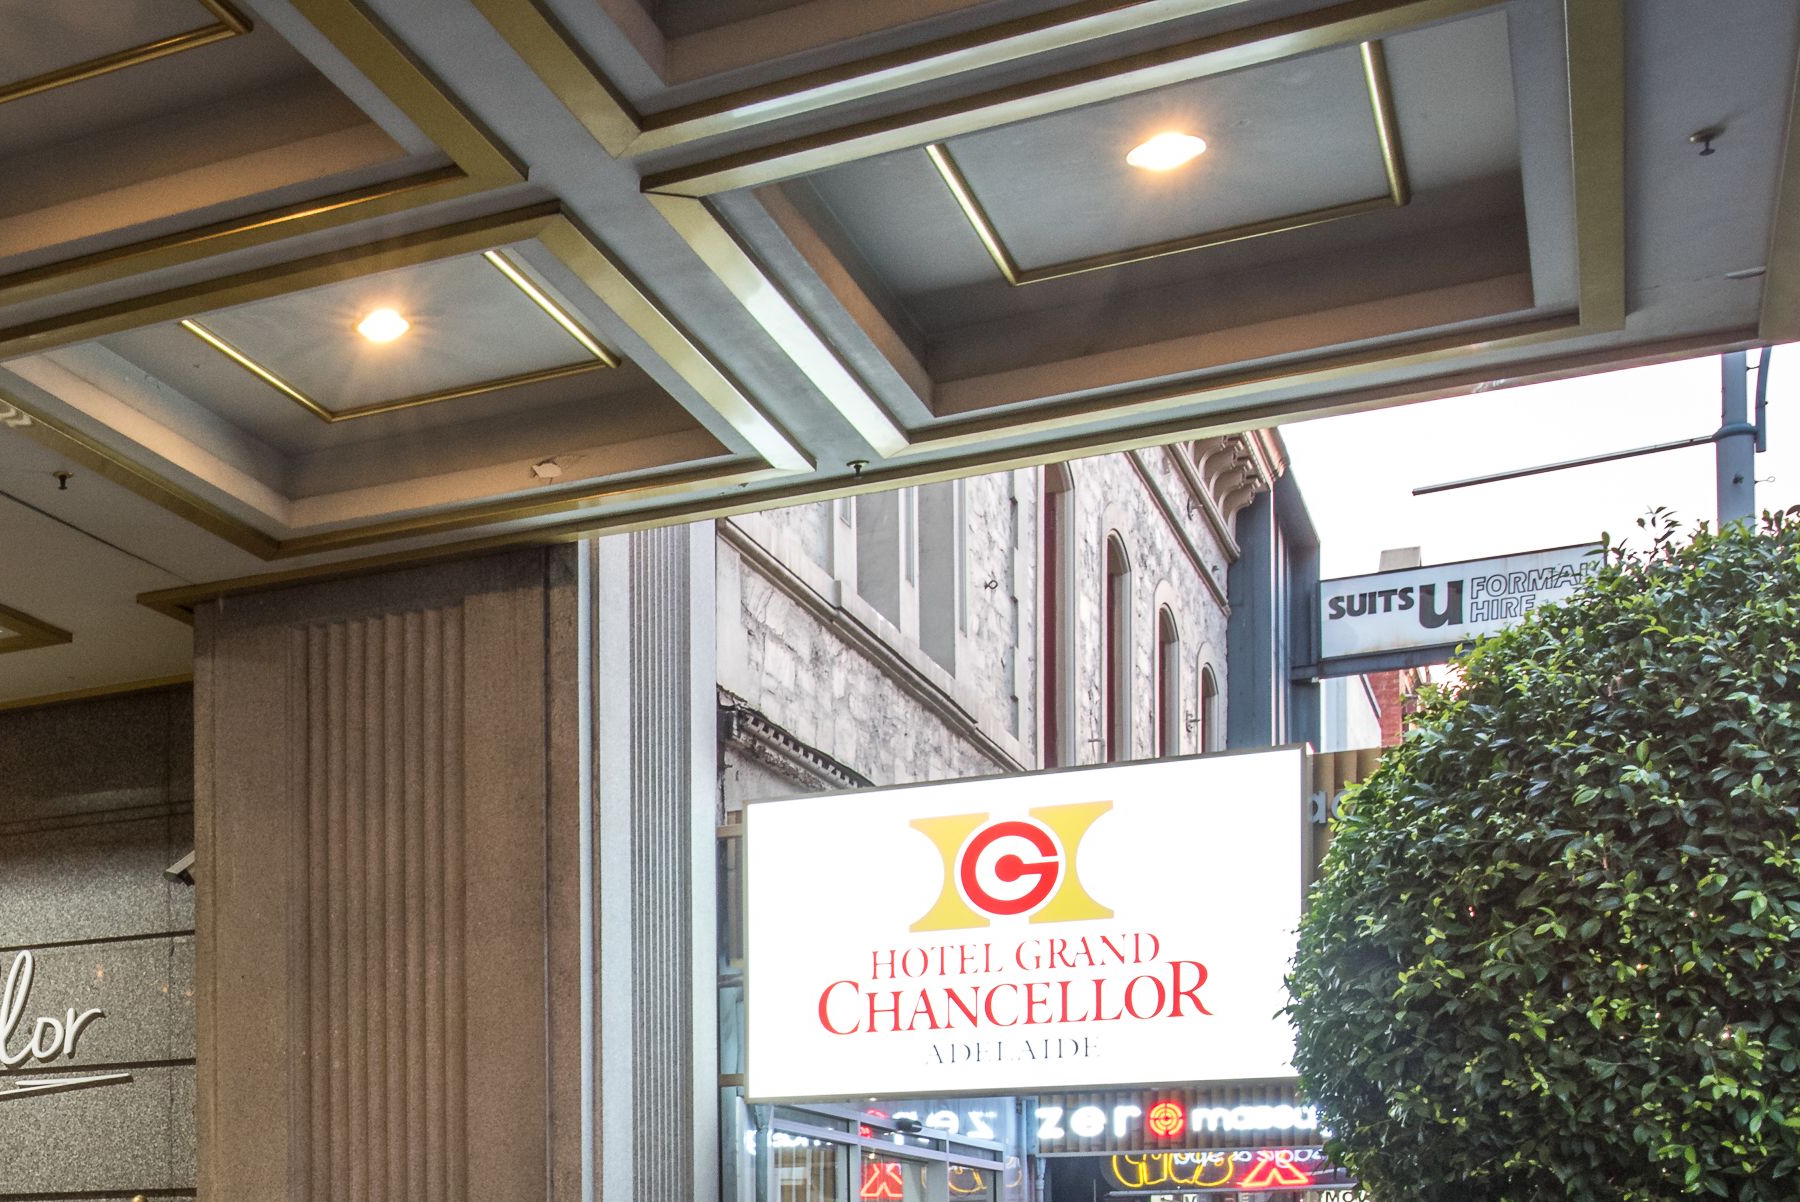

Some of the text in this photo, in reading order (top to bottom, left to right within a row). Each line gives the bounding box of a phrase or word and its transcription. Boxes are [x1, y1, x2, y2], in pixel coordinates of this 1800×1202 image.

[1328, 587, 1414, 620] SUITS
[872, 932, 1161, 981] HOTEL GRAND
[817, 960, 1216, 1036] CHANCELLOR
[925, 1036, 1101, 1065] ADELAIDE
